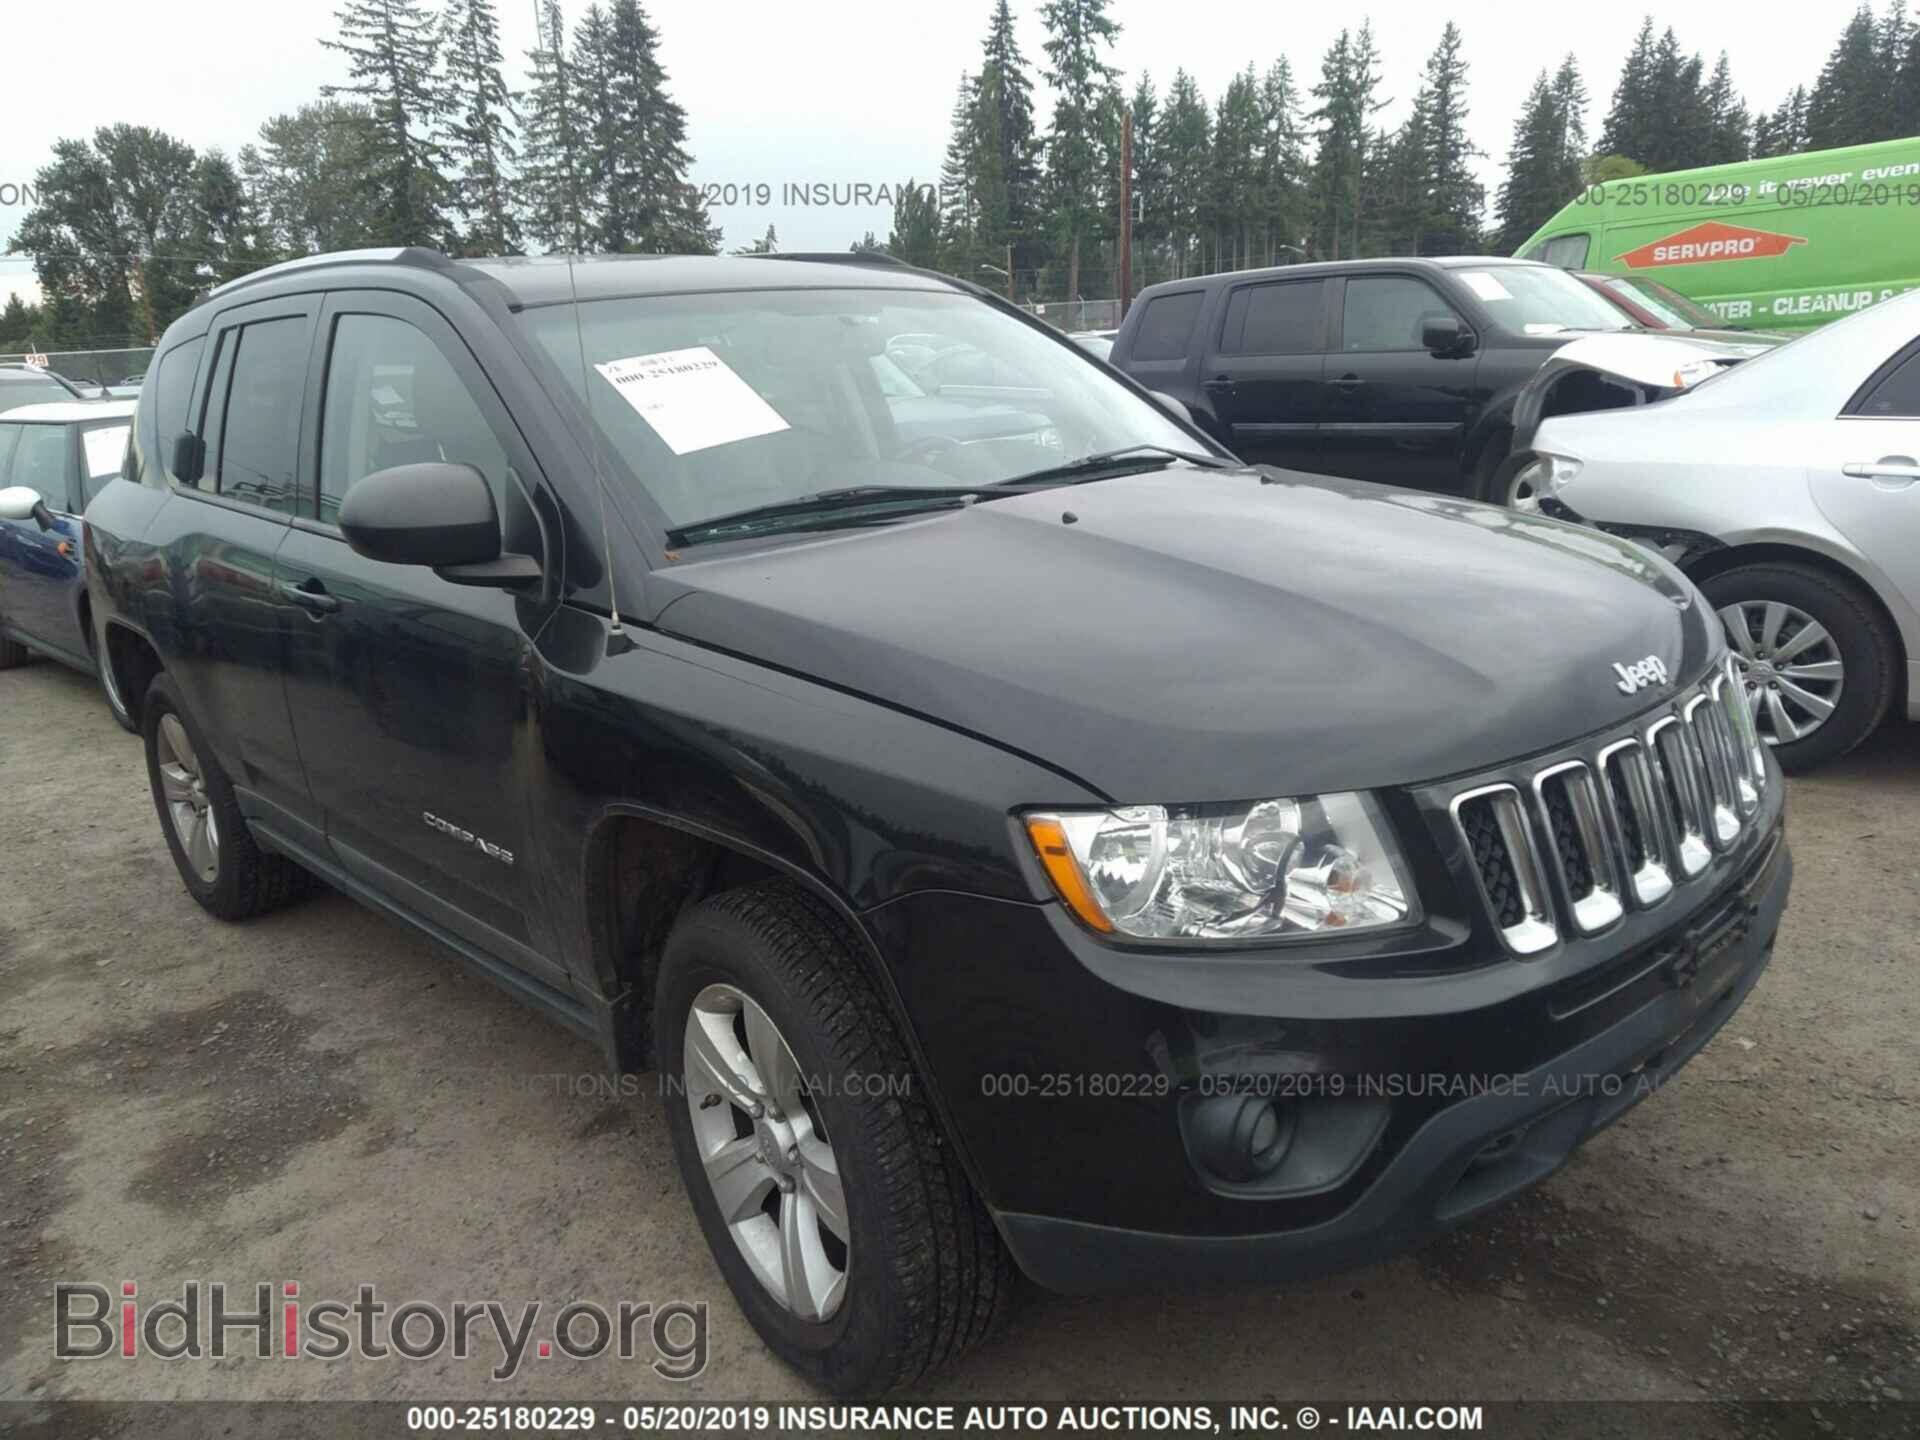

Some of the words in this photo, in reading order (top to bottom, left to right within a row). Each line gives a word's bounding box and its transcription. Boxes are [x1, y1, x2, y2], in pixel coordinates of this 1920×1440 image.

[1861, 163, 1920, 180] even
[1653, 237, 1755, 261] SERVPRO
[1704, 301, 1753, 319] ATER
[1772, 290, 1873, 315] CLEANUP
[1612, 655, 1668, 694] Jeep
[423, 810, 514, 864] COMPASS
